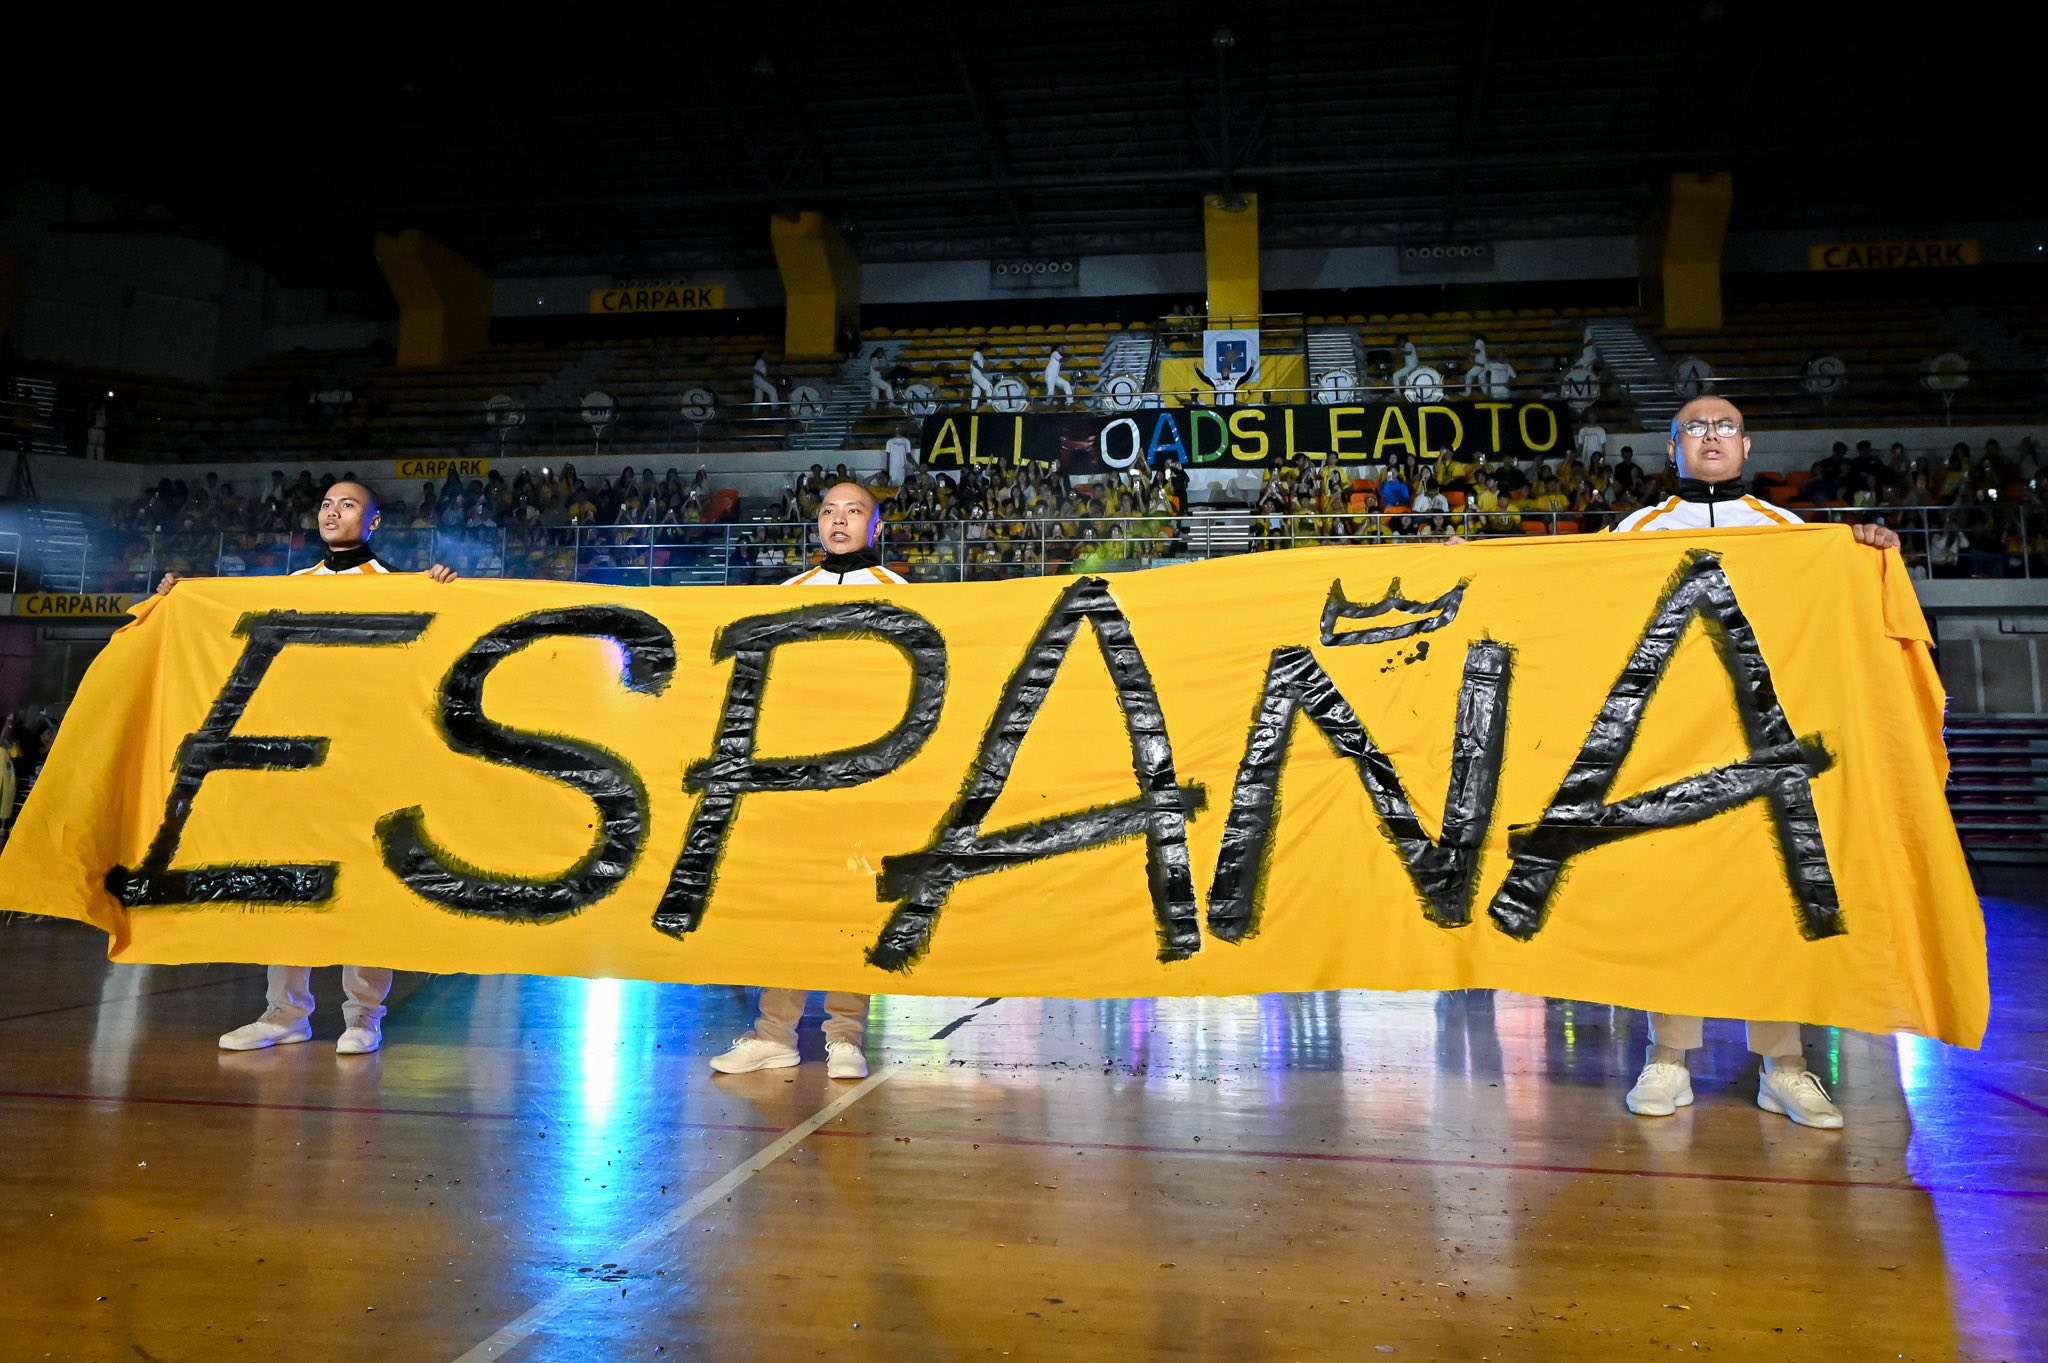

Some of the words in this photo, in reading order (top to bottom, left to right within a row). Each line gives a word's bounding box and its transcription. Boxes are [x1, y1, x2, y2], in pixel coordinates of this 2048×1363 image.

[1824, 243, 1966, 269] CARPARK
[602, 289, 713, 310] CARPARK
[928, 415, 1049, 469] ALL
[1285, 404, 1464, 461] LEAD
[1474, 402, 1559, 453] TO
[402, 460, 481, 475] CARPARK
[27, 595, 122, 614] CARPARK
